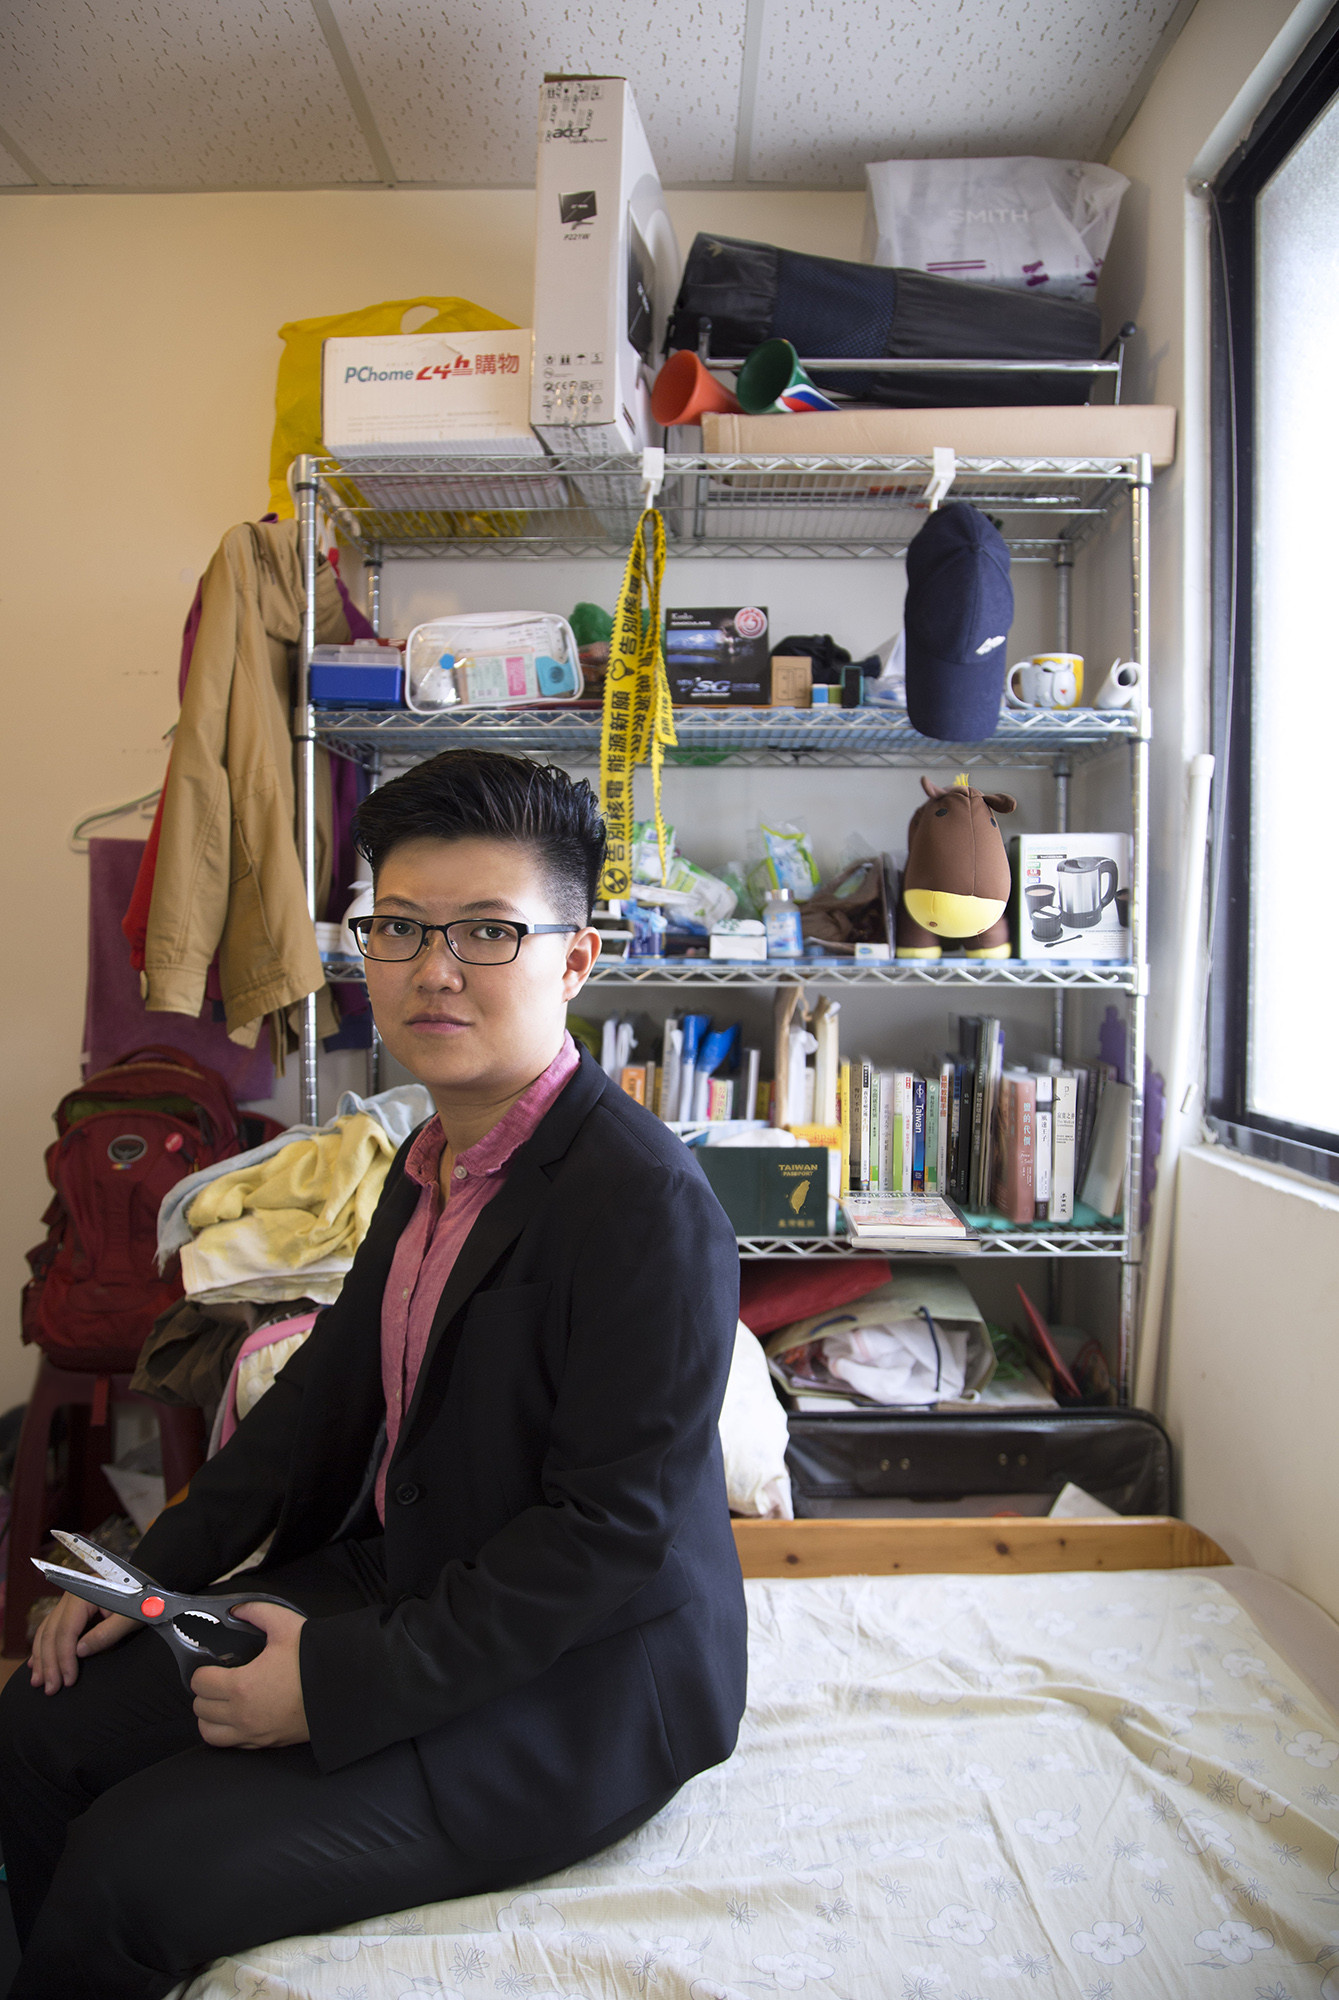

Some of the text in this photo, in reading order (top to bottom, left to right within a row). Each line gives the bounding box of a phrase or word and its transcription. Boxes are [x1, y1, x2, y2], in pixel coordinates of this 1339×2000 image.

[552, 127, 588, 138] acer
[344, 366, 414, 383] PChome
[475, 352, 520, 375] 購物
[606, 689, 631, 862] 告別核電 能源新願
[915, 1103, 924, 1134] Taiwan
